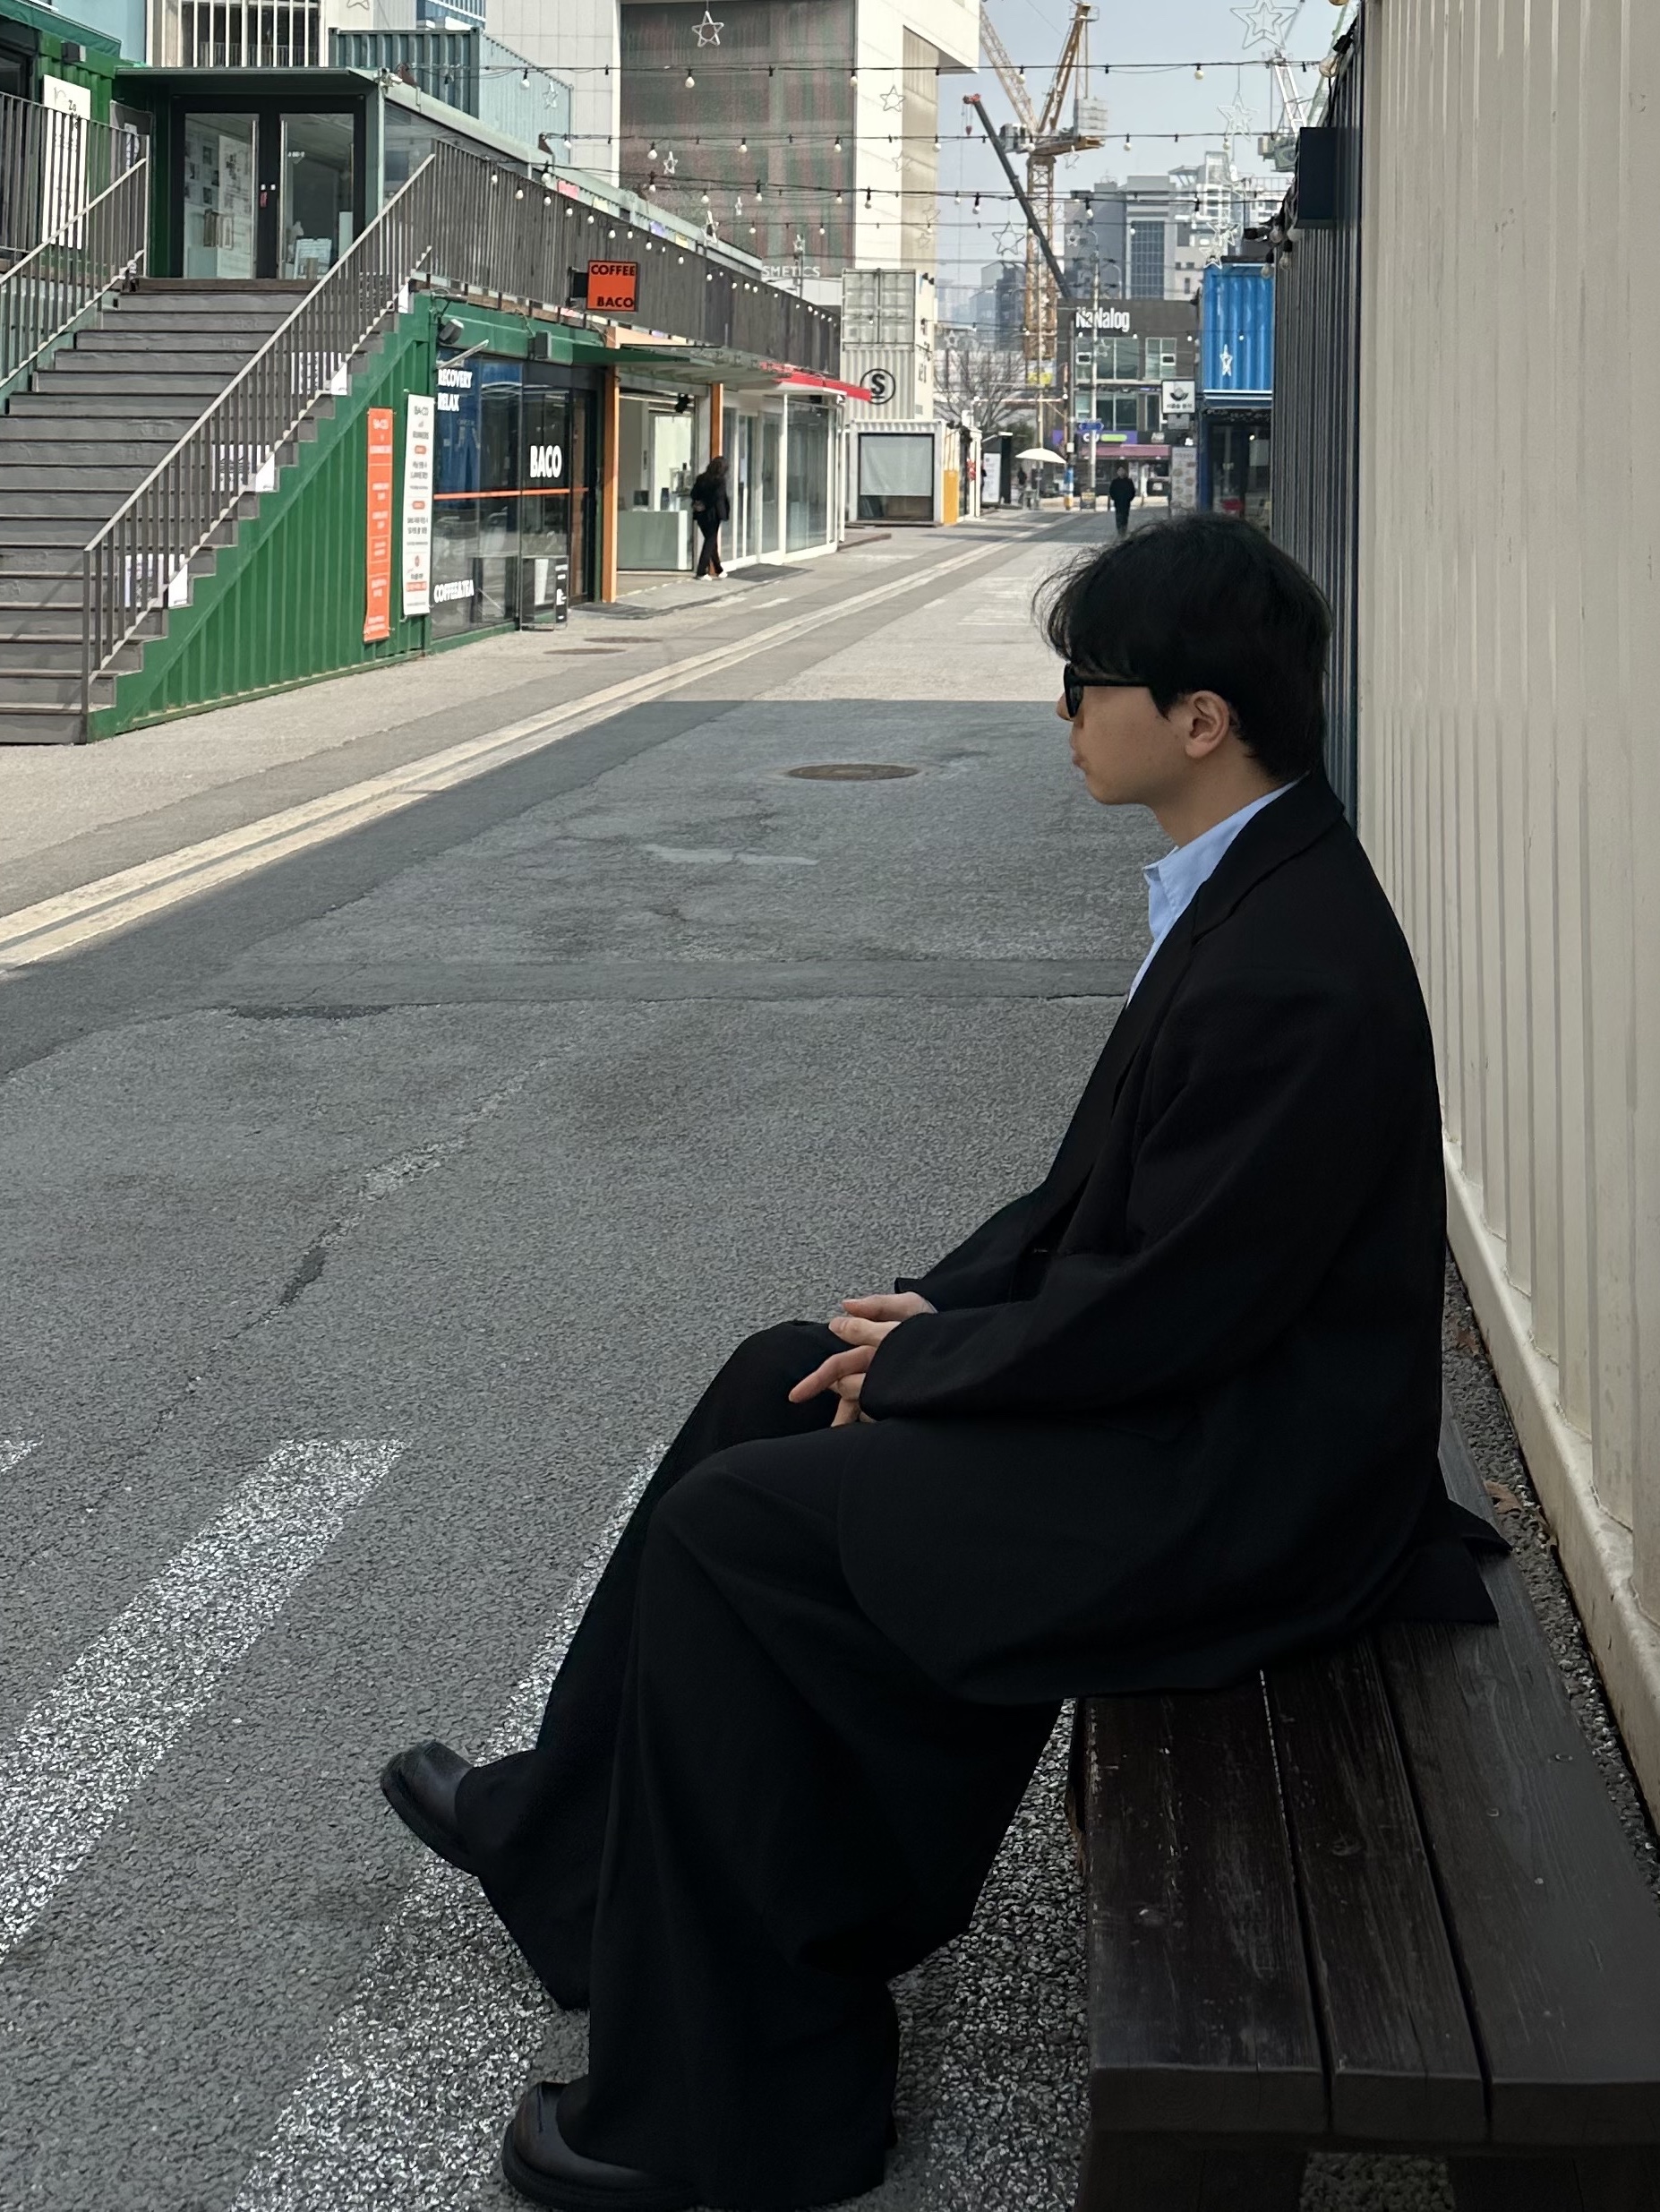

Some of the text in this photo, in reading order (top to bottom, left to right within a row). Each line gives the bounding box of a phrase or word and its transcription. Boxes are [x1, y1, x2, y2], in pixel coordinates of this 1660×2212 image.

[591, 264, 635, 276] COFFEE
[597, 296, 633, 308] BACO
[438, 368, 473, 388] RECOVERY
[437, 392, 460, 411] RELAX
[530, 445, 562, 478] BACO
